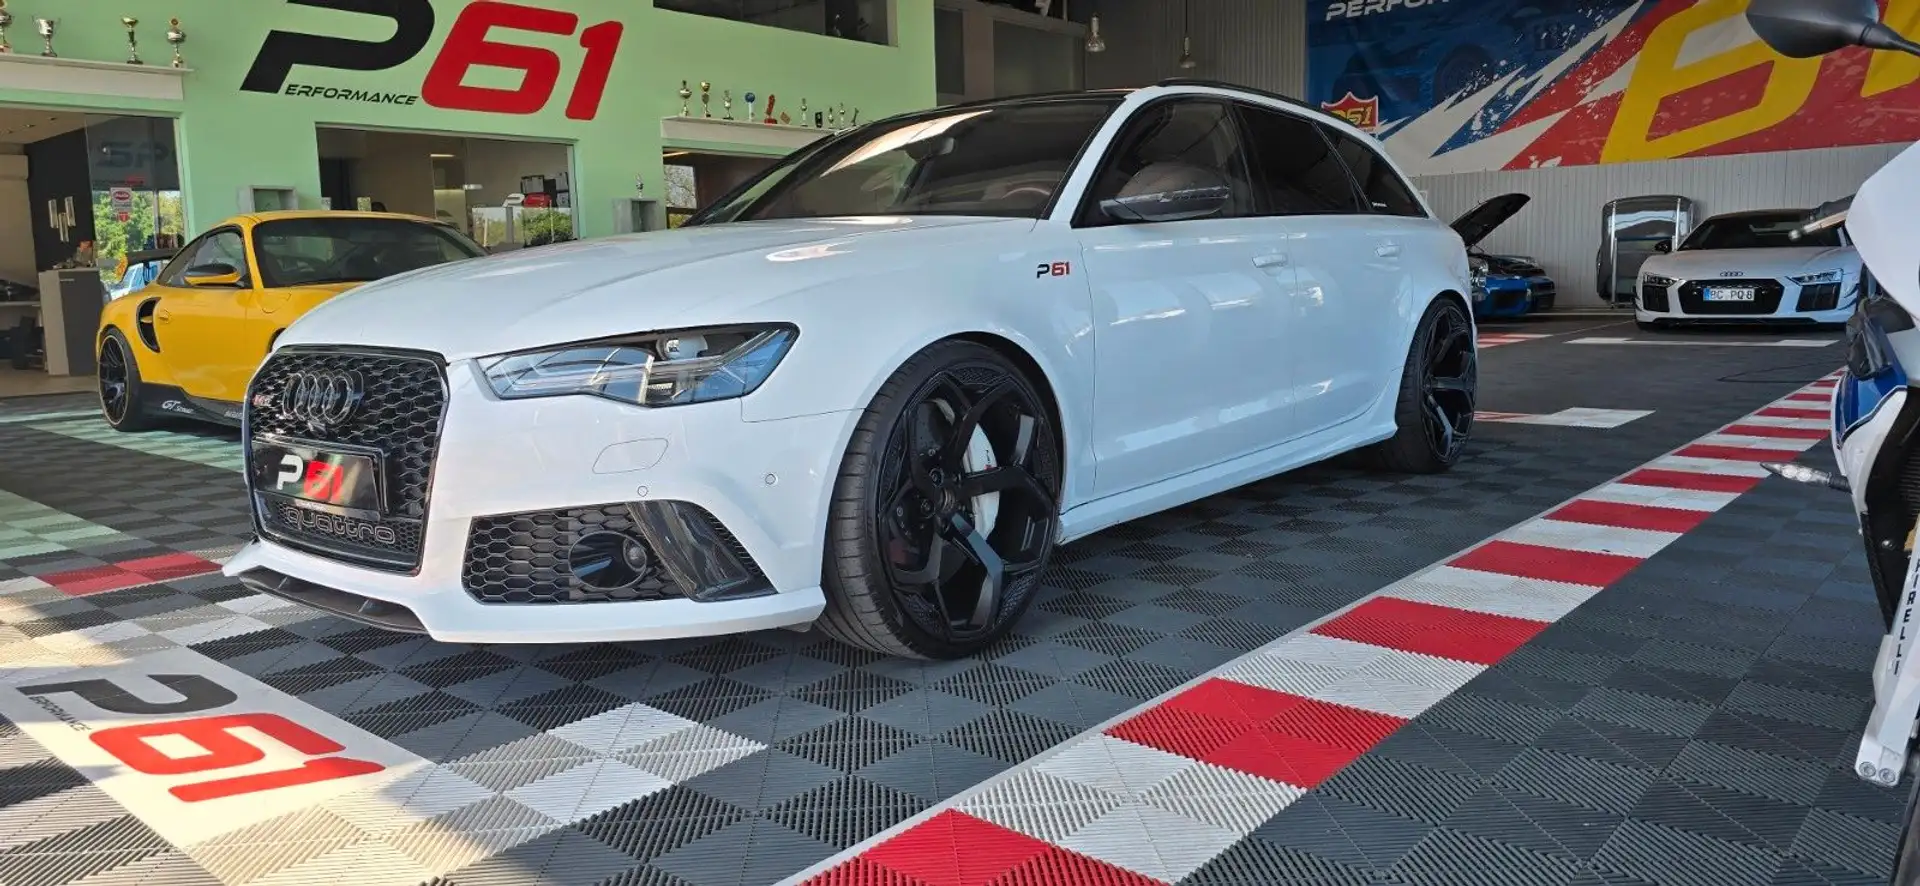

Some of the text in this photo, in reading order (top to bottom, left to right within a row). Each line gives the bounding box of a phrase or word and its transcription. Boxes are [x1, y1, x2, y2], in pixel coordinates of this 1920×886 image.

[1325, 0, 1449, 21] PERFO
[239, 0, 624, 121] P61
[285, 84, 418, 106] ERFORMANCE
[1036, 261, 1070, 279] P61
[276, 454, 344, 503] P61
[285, 508, 396, 544] quattro
[15, 674, 386, 803] P61
